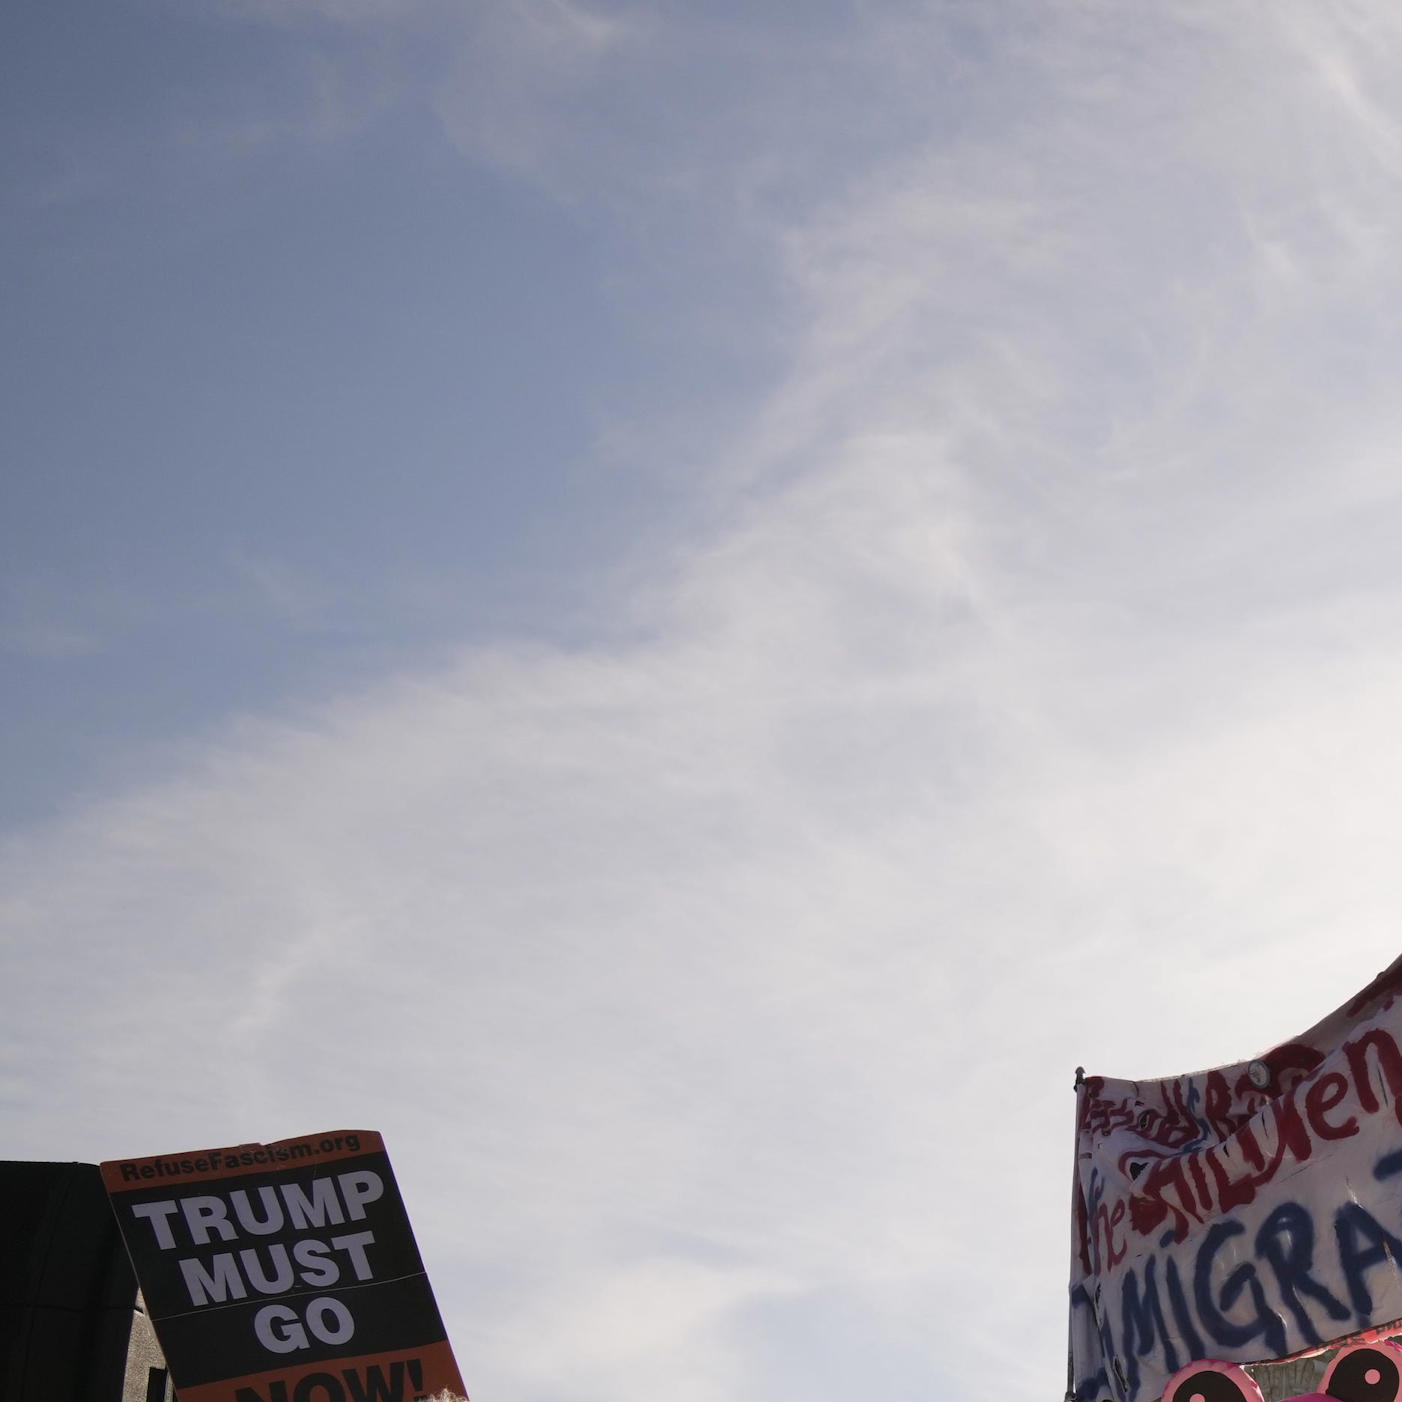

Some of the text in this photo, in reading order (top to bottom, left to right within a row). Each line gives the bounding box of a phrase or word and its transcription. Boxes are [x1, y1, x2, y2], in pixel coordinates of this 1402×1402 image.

[119, 1131, 361, 1183] RefuseFascism.org
[131, 1170, 385, 1251] TRUMP
[178, 1231, 376, 1307] MUST
[253, 1296, 356, 1354] GO
